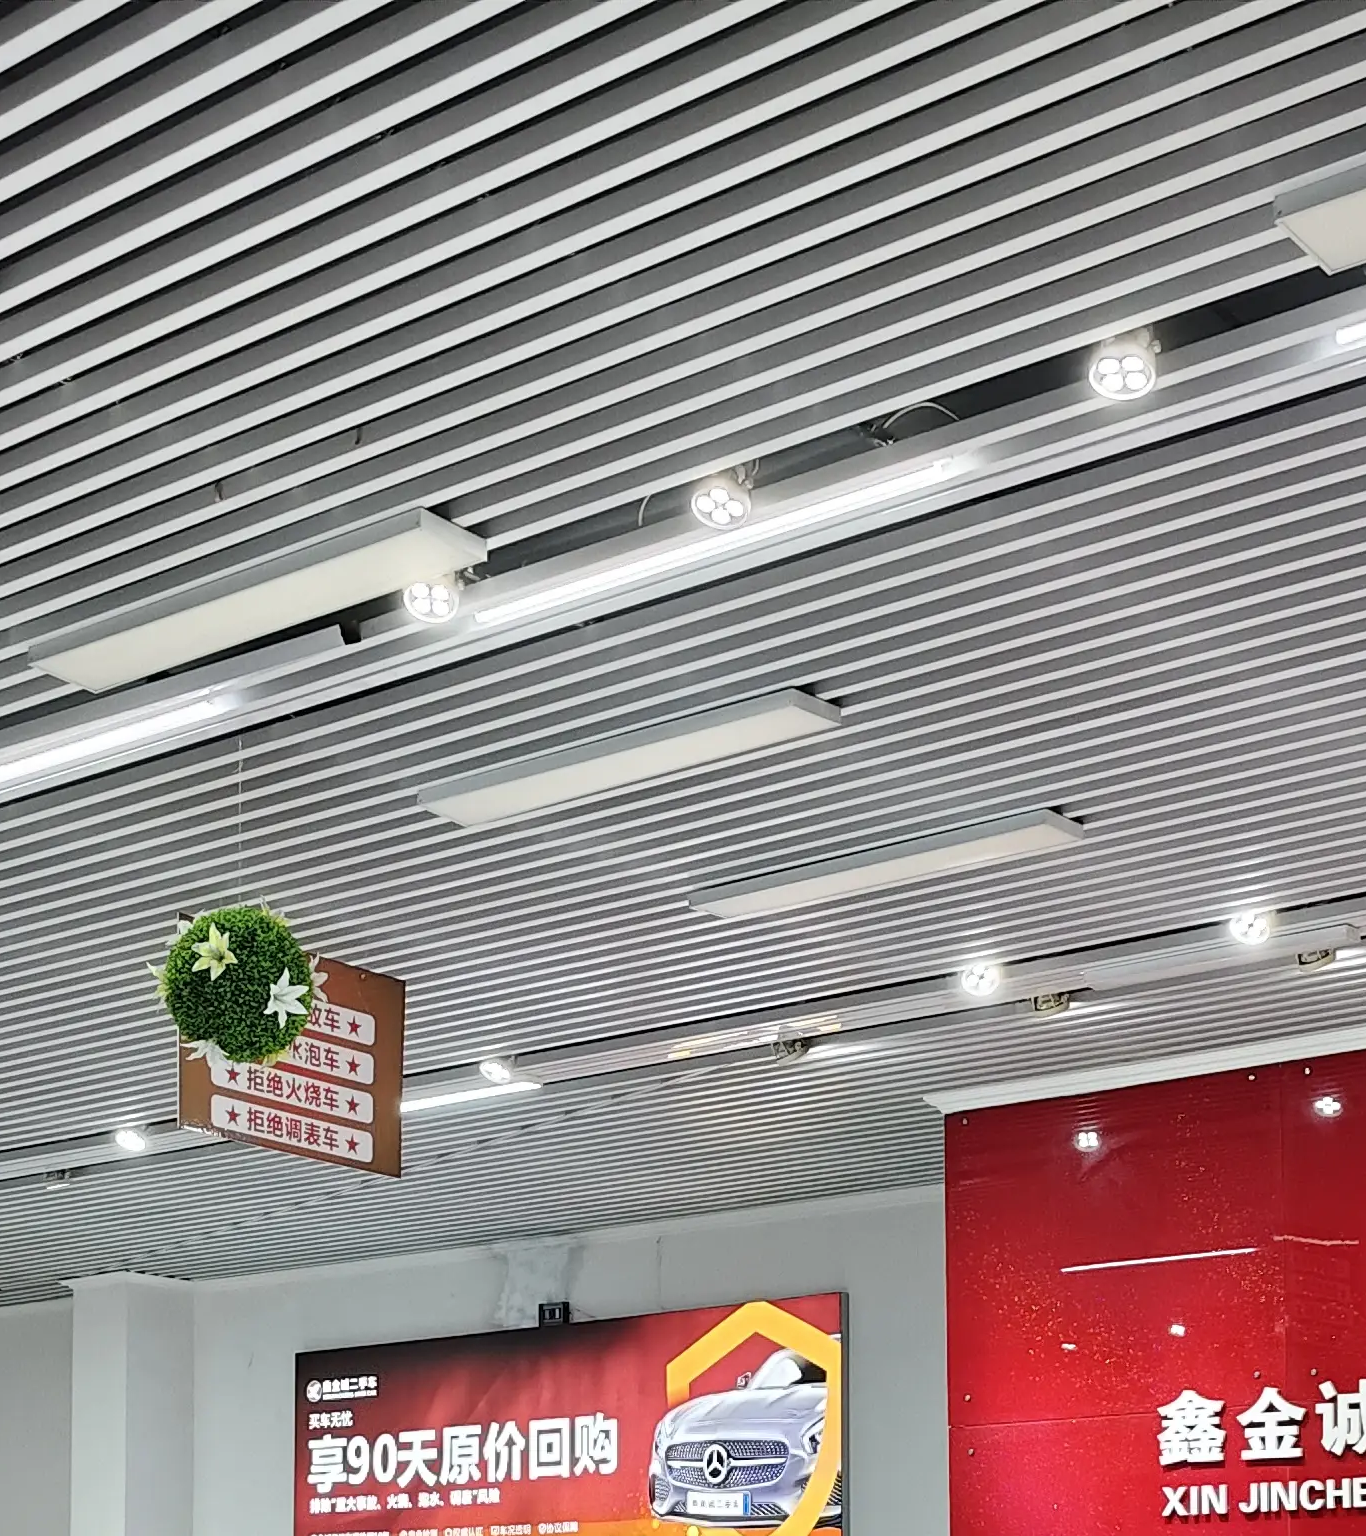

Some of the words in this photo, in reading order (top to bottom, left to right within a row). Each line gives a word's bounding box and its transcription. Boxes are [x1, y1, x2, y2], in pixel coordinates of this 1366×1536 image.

[246, 1068, 341, 1116] 拒绝火烧车
[246, 1106, 341, 1151] 拒绝调表车
[308, 1410, 353, 1430] 买车无忧
[307, 1412, 618, 1494] 享90天原价回购
[1161, 1485, 1228, 1518] XIN
